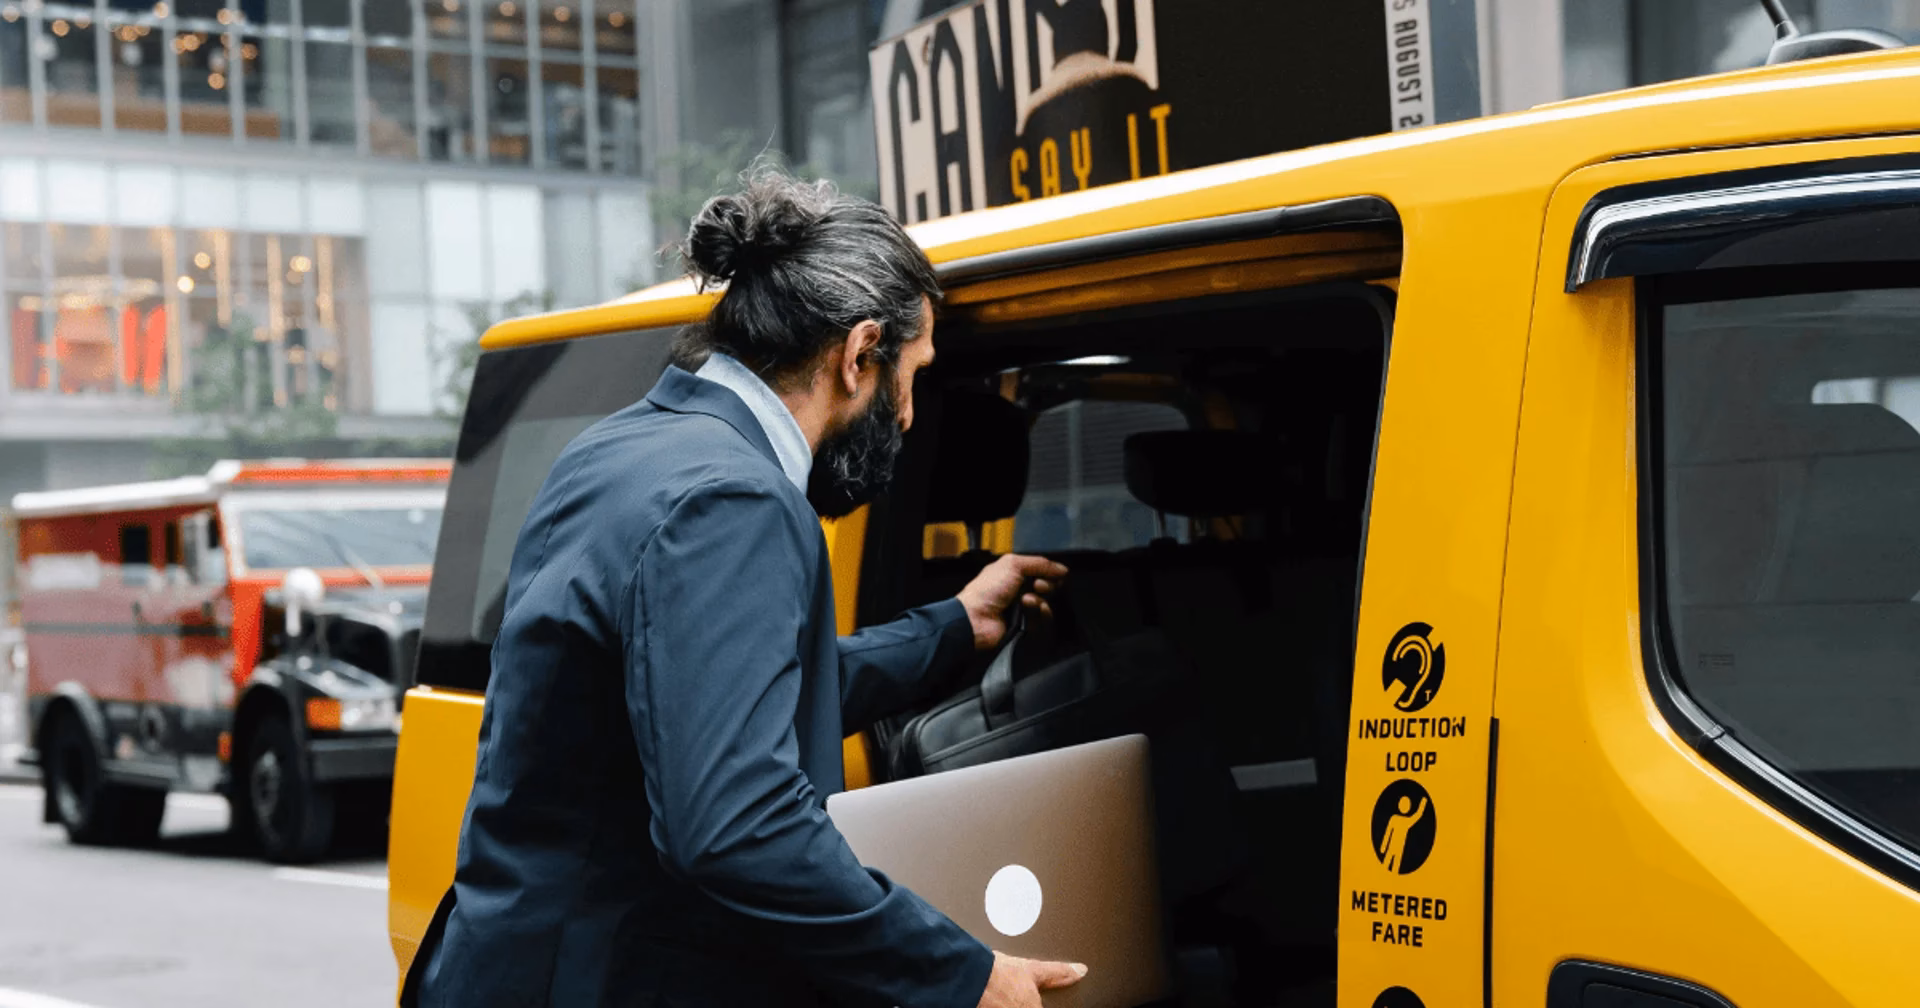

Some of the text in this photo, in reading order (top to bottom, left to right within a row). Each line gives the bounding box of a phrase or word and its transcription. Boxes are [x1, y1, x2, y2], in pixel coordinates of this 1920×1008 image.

[1394, 19, 1422, 104] AUGUST
[1010, 103, 1172, 201] SAY IT
[1358, 716, 1466, 739] INDUCTION
[1385, 751, 1437, 772] LOOP
[1351, 889, 1448, 921] METERED
[1371, 921, 1424, 948] FARE
